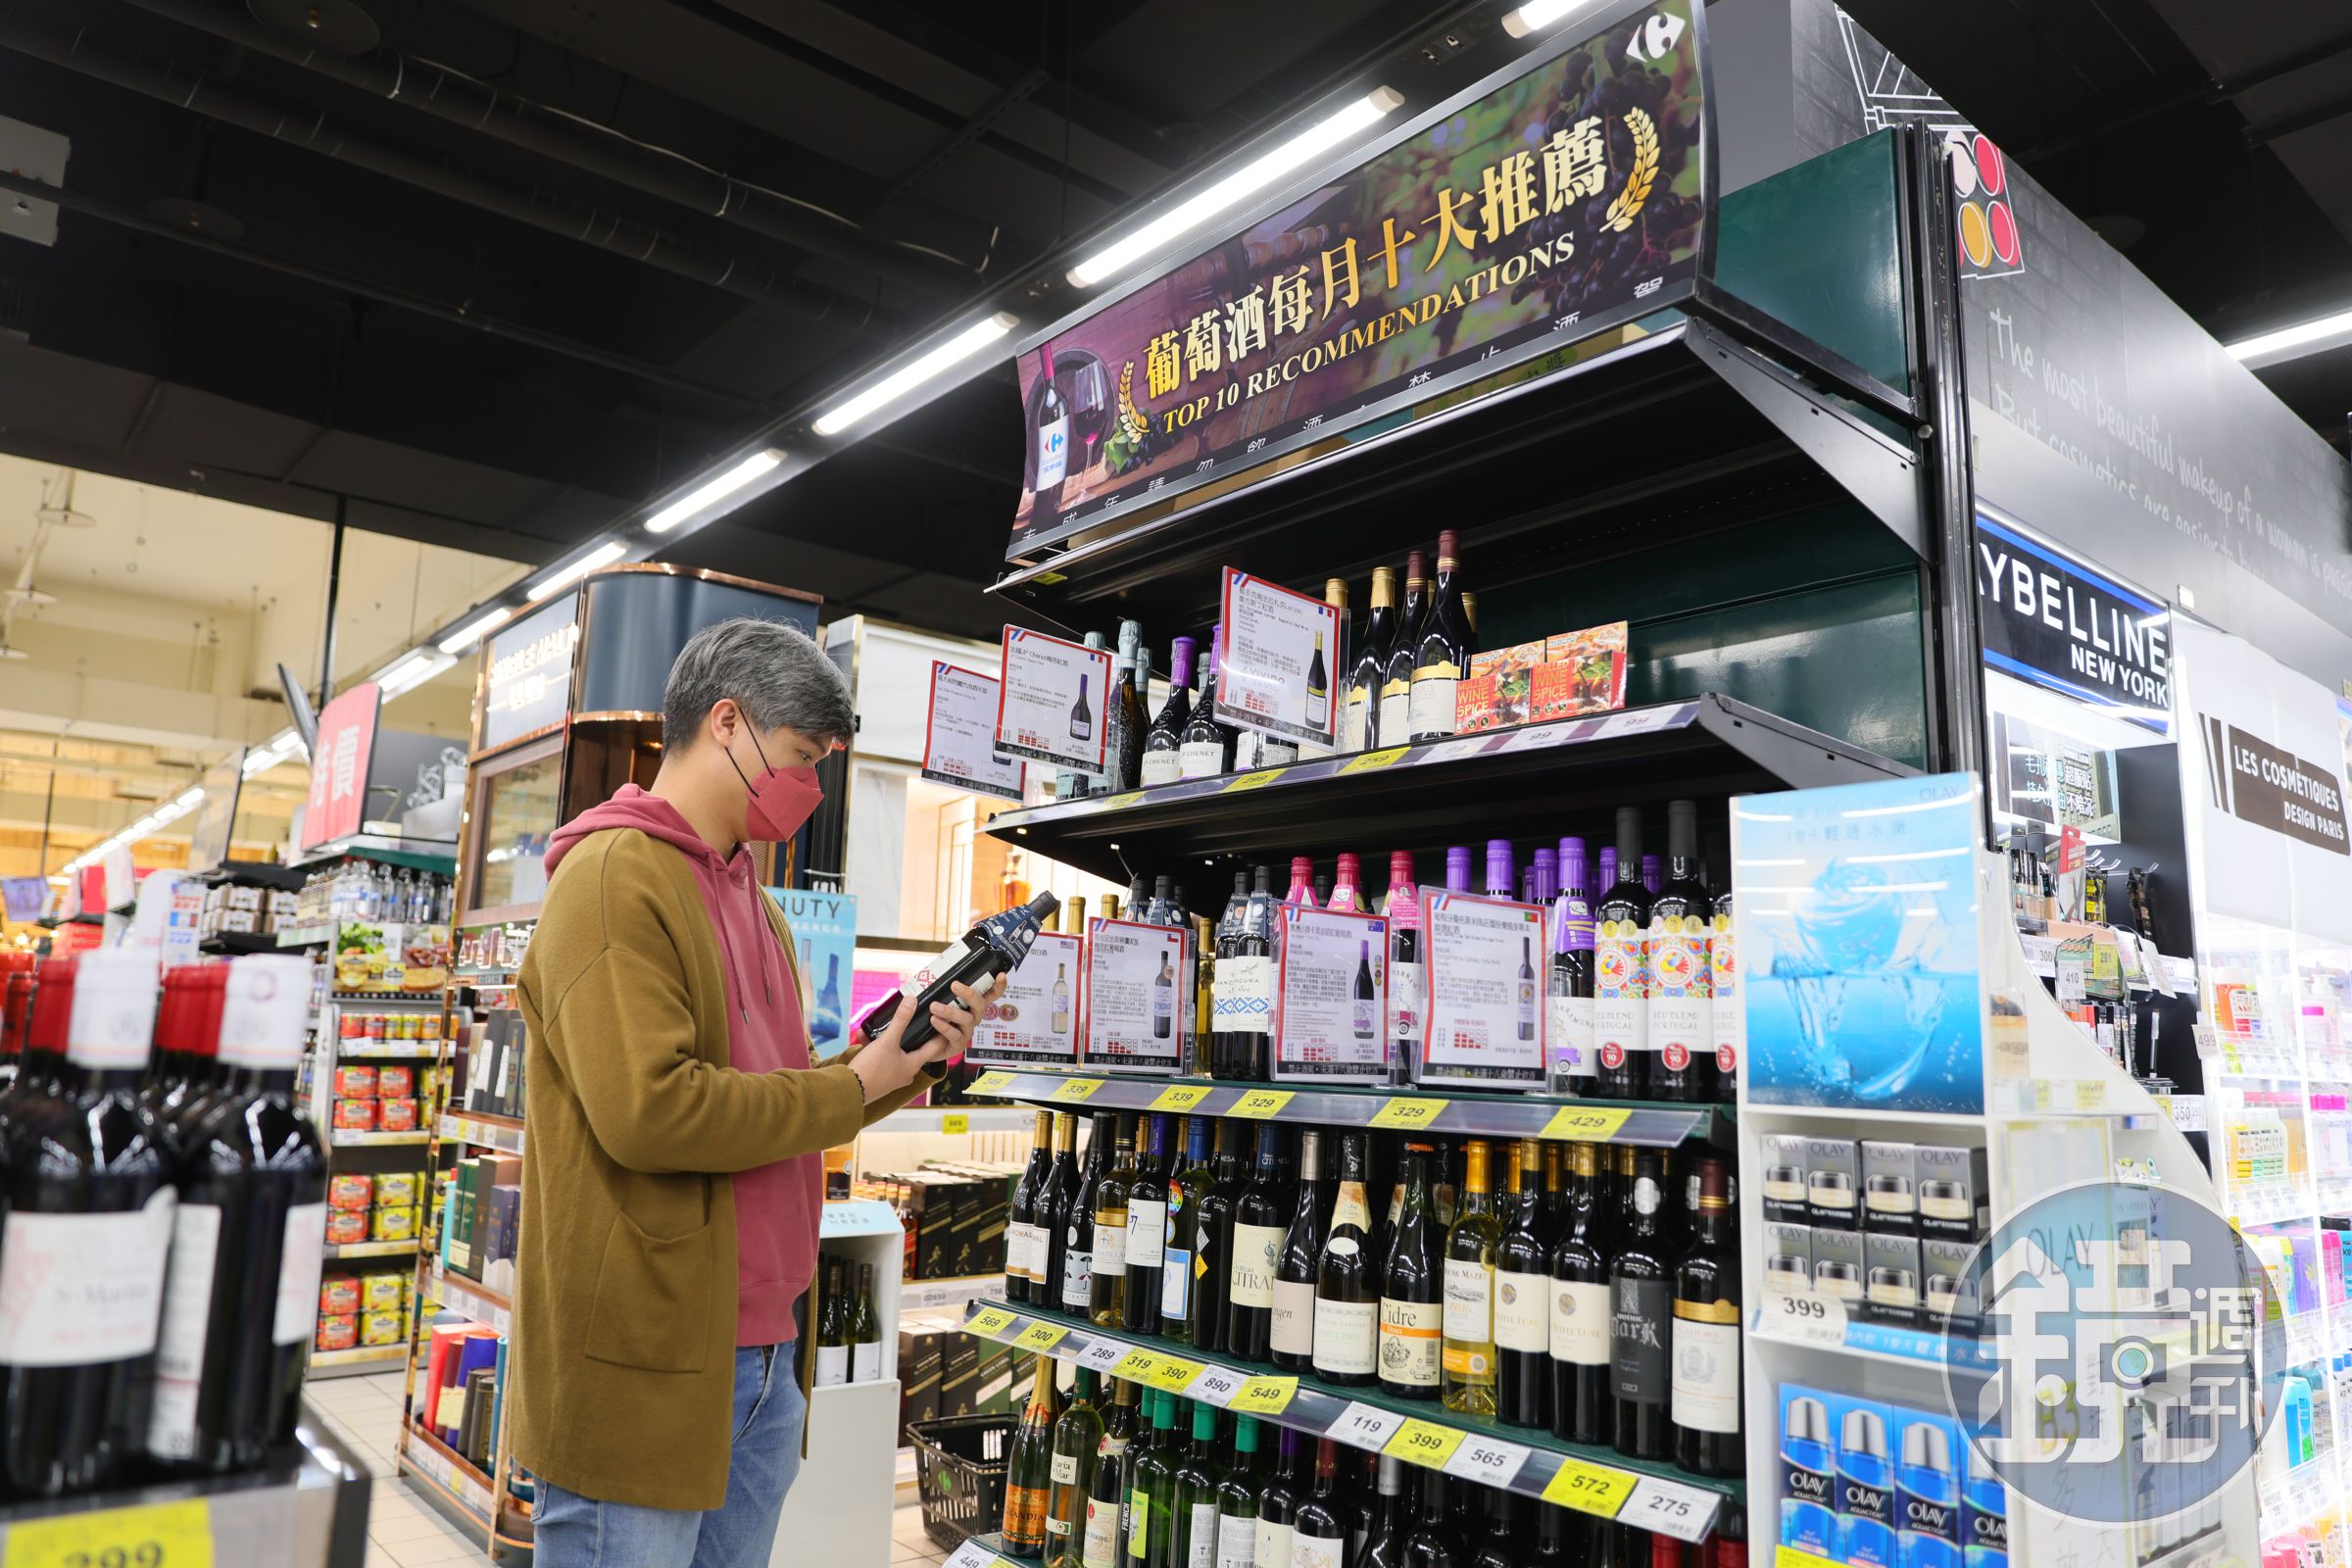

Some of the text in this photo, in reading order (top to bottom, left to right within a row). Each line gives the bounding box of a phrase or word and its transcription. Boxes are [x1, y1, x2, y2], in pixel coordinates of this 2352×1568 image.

[1144, 116, 1607, 399] 葡萄酒每月十大推薦
[1163, 391, 1210, 434] TOP
[1215, 379, 1241, 413] 10
[1246, 231, 1576, 399] RECOMMENDATIONS
[1989, 307, 2034, 380] The
[2041, 357, 2088, 416] most
[2094, 377, 2174, 476] beautiful
[2179, 455, 2233, 528] makeup
[1533, 661, 1568, 674] MULLED
[1533, 671, 1567, 686] WINE
[2071, 644, 2170, 709] NEW YORK
[1457, 677, 1490, 692] MULLED
[1457, 691, 1490, 704] WINE
[1533, 685, 1568, 702] SPICE
[1456, 702, 1490, 717] SPICE
[2234, 745, 2259, 777] LES
[1919, 786, 1961, 802] OLAY
[2283, 801, 2344, 841] DESIGN PARIS
[2039, 950, 2053, 962] 300
[2065, 972, 2080, 984] 410
[1669, 1010, 1700, 1020] BLEND
[1652, 1021, 1698, 1031] PORTUGAL
[2198, 1033, 2217, 1048] 499
[1606, 1052, 1618, 1062] 90
[1669, 1054, 1682, 1063] 90
[1065, 1083, 1088, 1095] 339
[1167, 1092, 1195, 1102] 339
[1248, 1098, 1276, 1109] 329
[1393, 1105, 1427, 1118] 329
[2175, 1106, 2191, 1120] 350
[1568, 1115, 1607, 1129] 429
[1810, 1141, 1849, 1156] OLAY
[1921, 1150, 1962, 1164] OLAY
[1819, 1231, 1855, 1248] OLAY
[1871, 1237, 1911, 1253] OLAY
[1381, 1302, 1417, 1328] Cidre
[1784, 1297, 1826, 1319] 399
[979, 1316, 1002, 1328] 569
[1030, 1330, 1054, 1342] 300
[1387, 1326, 1402, 1335] Doux
[1092, 1347, 1116, 1360] 289
[1127, 1356, 1152, 1369] 319
[1162, 1366, 1188, 1380] 390
[1204, 1377, 1232, 1393] 890
[1250, 1387, 1282, 1400] 549
[1351, 1414, 1383, 1433] 119
[1408, 1432, 1443, 1450] 399
[1470, 1448, 1506, 1468] 565
[1571, 1474, 1610, 1495] 572
[1789, 1471, 1827, 1495] OLAY
[1648, 1494, 1692, 1516] 275
[1845, 1487, 1885, 1510] OLAY
[1121, 1502, 1131, 1532] FRENCH
[1907, 1501, 1947, 1528] OLAY
